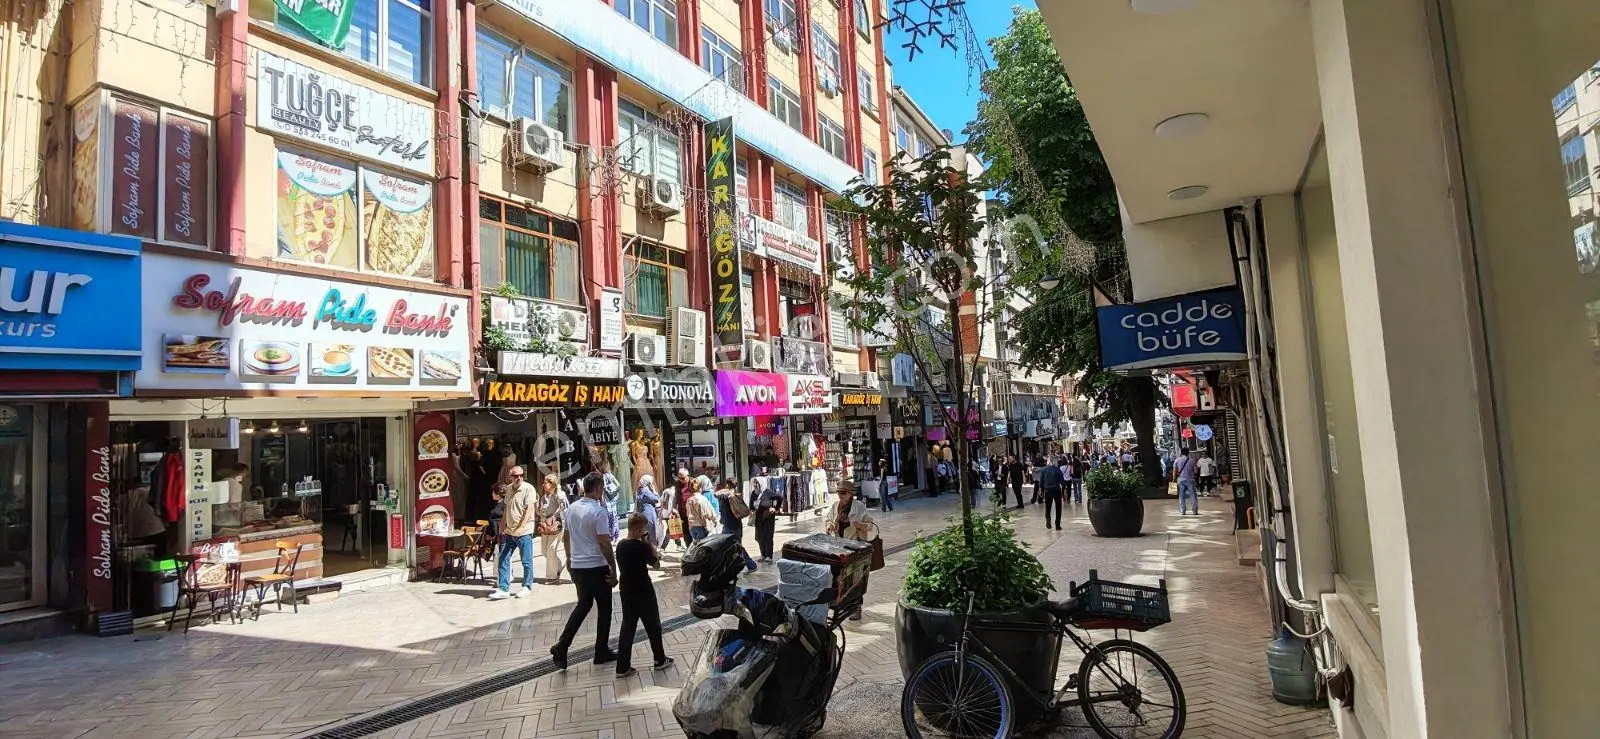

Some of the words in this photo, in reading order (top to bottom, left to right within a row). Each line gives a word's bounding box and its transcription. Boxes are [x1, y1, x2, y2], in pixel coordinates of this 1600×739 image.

[265, 66, 358, 133] TUĞÇE
[125, 113, 142, 149] Bank
[274, 107, 321, 130] BEAUTY
[176, 125, 191, 159] Bank
[123, 150, 140, 180] Pide
[295, 154, 343, 176] Sofram
[378, 174, 418, 195] Sofram
[121, 182, 144, 229] Sofram
[174, 190, 195, 237] Sofram
[710, 135, 736, 304] KARAGÖZ
[172, 272, 308, 328] Sofram
[313, 287, 377, 330] Pide
[382, 299, 453, 336] Bank
[1120, 299, 1233, 329] cadde
[1137, 326, 1222, 352] büfe
[488, 380, 570, 402] KARAGÖZ
[575, 381, 588, 407] İŞ
[593, 387, 625, 403] HANI
[648, 377, 714, 401] PRONOVA
[736, 385, 777, 404] AVON
[585, 415, 619, 429] PRONOVA
[589, 430, 618, 444] ABİYE
[92, 446, 111, 483] Bank
[92, 486, 111, 529] Pide
[92, 529, 112, 579] Sofram
